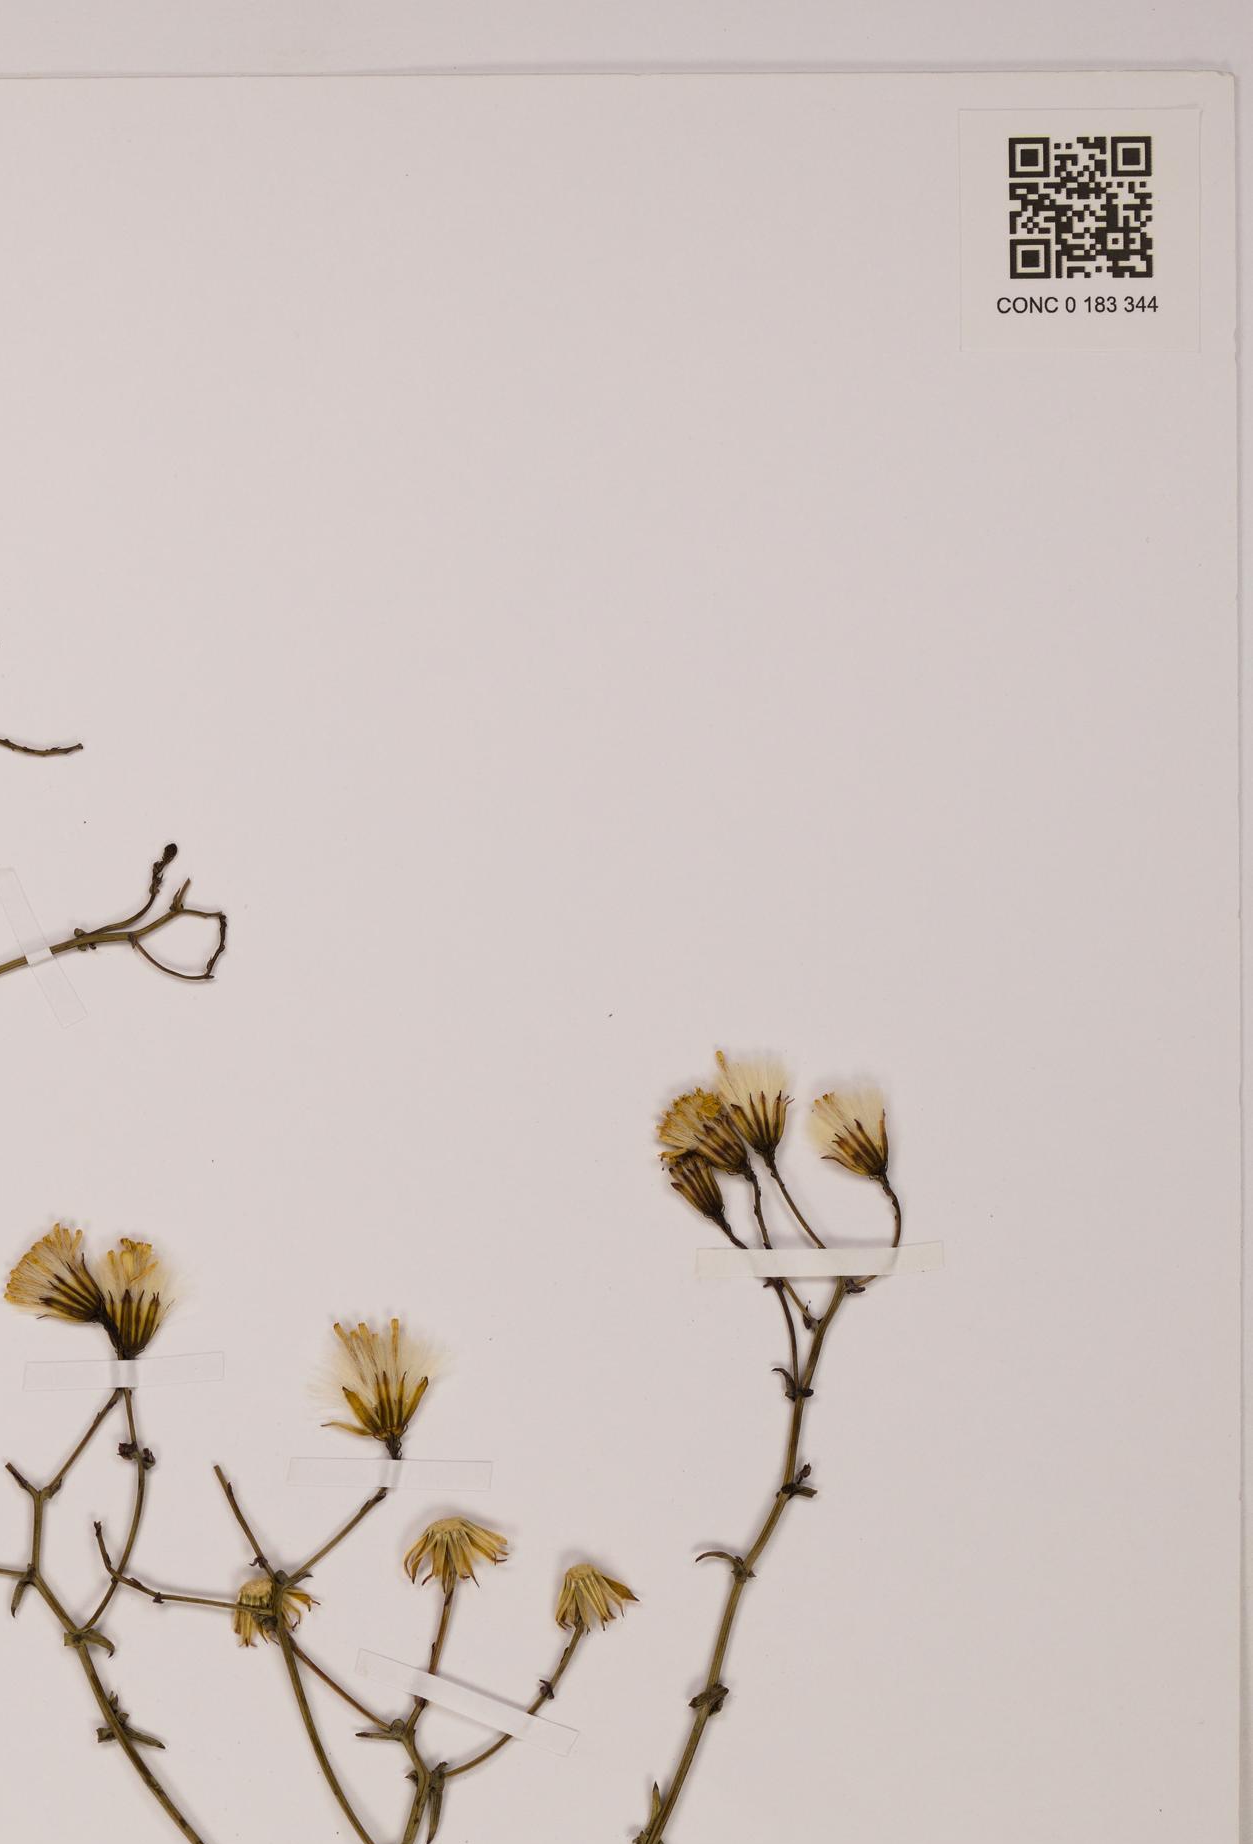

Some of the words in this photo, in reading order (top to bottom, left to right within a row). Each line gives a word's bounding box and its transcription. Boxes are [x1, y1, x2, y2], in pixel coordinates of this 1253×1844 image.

[996, 296, 1059, 314] CONC
[1065, 297, 1077, 314] 0
[1083, 296, 1118, 314] 183
[1123, 296, 1159, 313] 344
